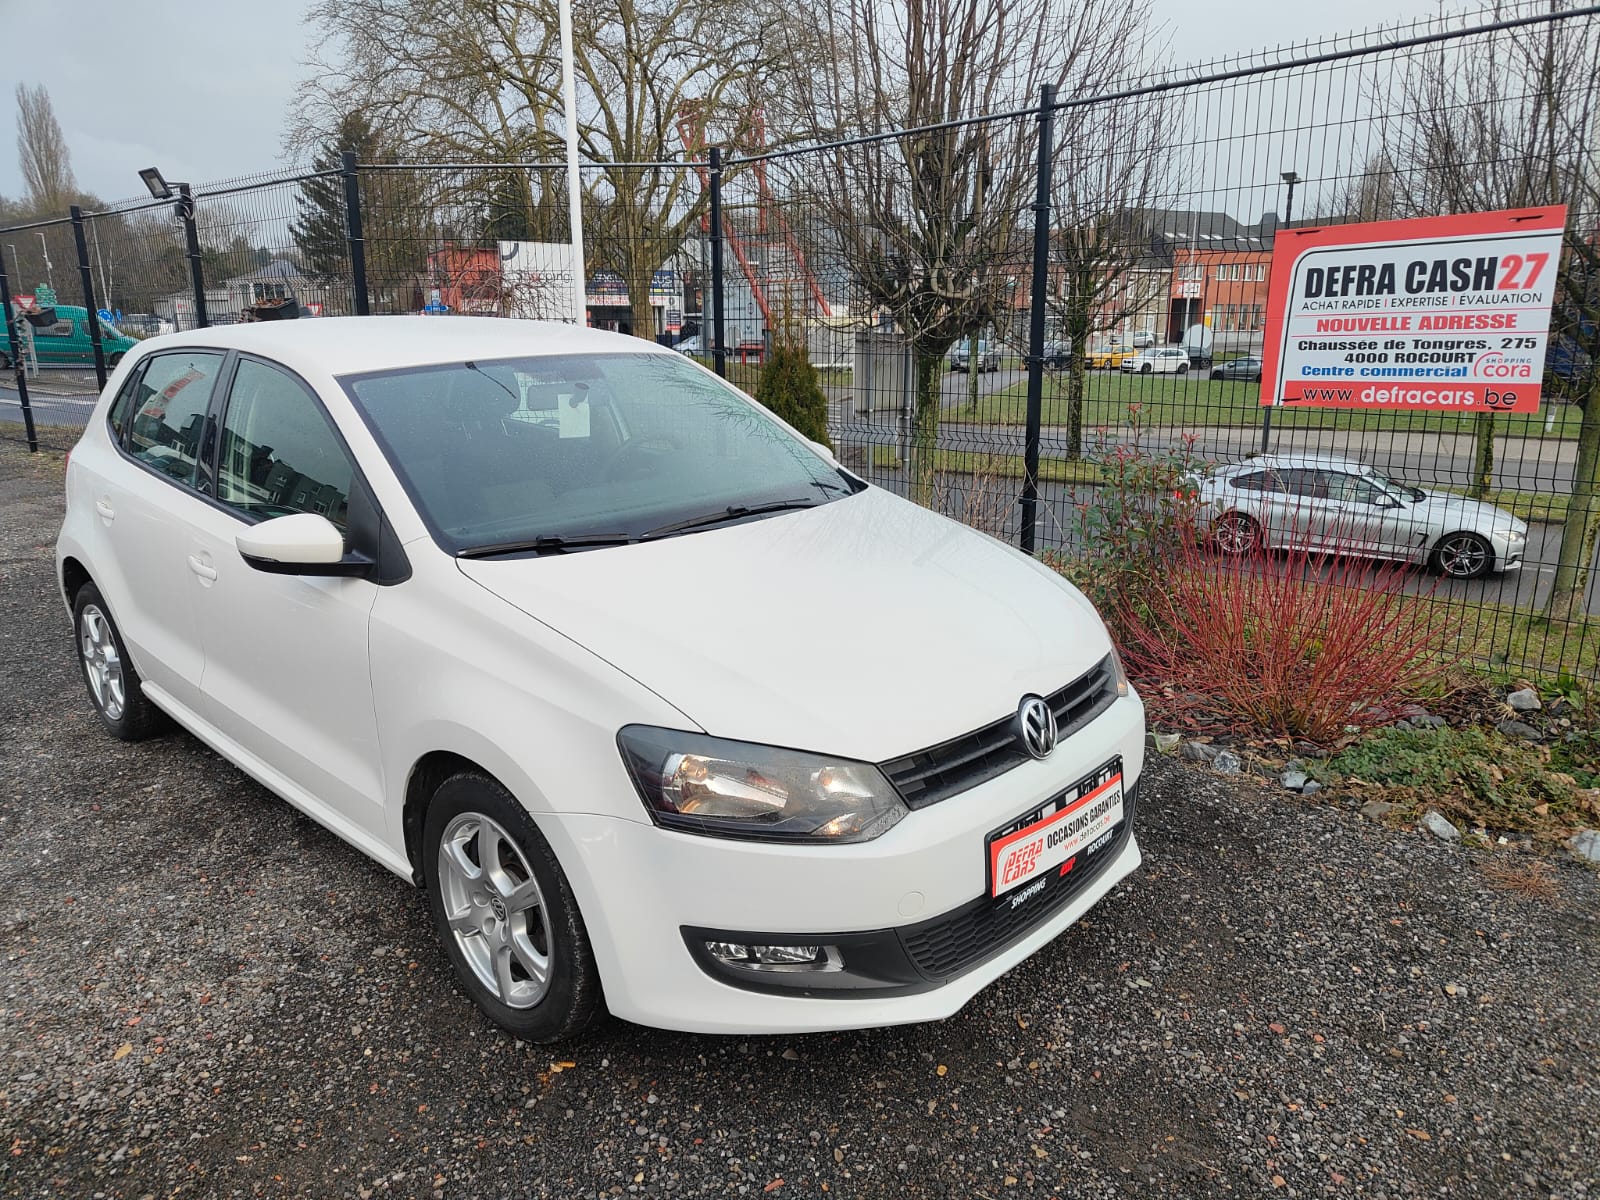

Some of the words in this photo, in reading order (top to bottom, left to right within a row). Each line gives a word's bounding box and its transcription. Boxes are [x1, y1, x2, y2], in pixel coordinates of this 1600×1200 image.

[1304, 262, 1396, 299] DEFRA
[1301, 300, 1340, 311] ACHAT
[1342, 298, 1381, 310] RAPIDE
[1391, 296, 1449, 308] EXPERTISE
[1316, 316, 1412, 333] NOUVELLE
[1418, 313, 1518, 331] ADRESSE
[1297, 340, 1379, 351] Chaussée
[1383, 339, 1406, 350] de
[1500, 337, 1537, 349] 275
[1344, 352, 1389, 363] 4000
[1394, 352, 1477, 363] ROCOURT
[1301, 365, 1355, 376] Centre
[1360, 366, 1468, 377] commercial
[1482, 364, 1532, 378] cora
[1047, 811, 1089, 849] OCCASIONS
[1089, 789, 1121, 823] GARANTIES
[1087, 828, 1114, 856] ROCOURT
[1010, 878, 1046, 909] SHOPPING
